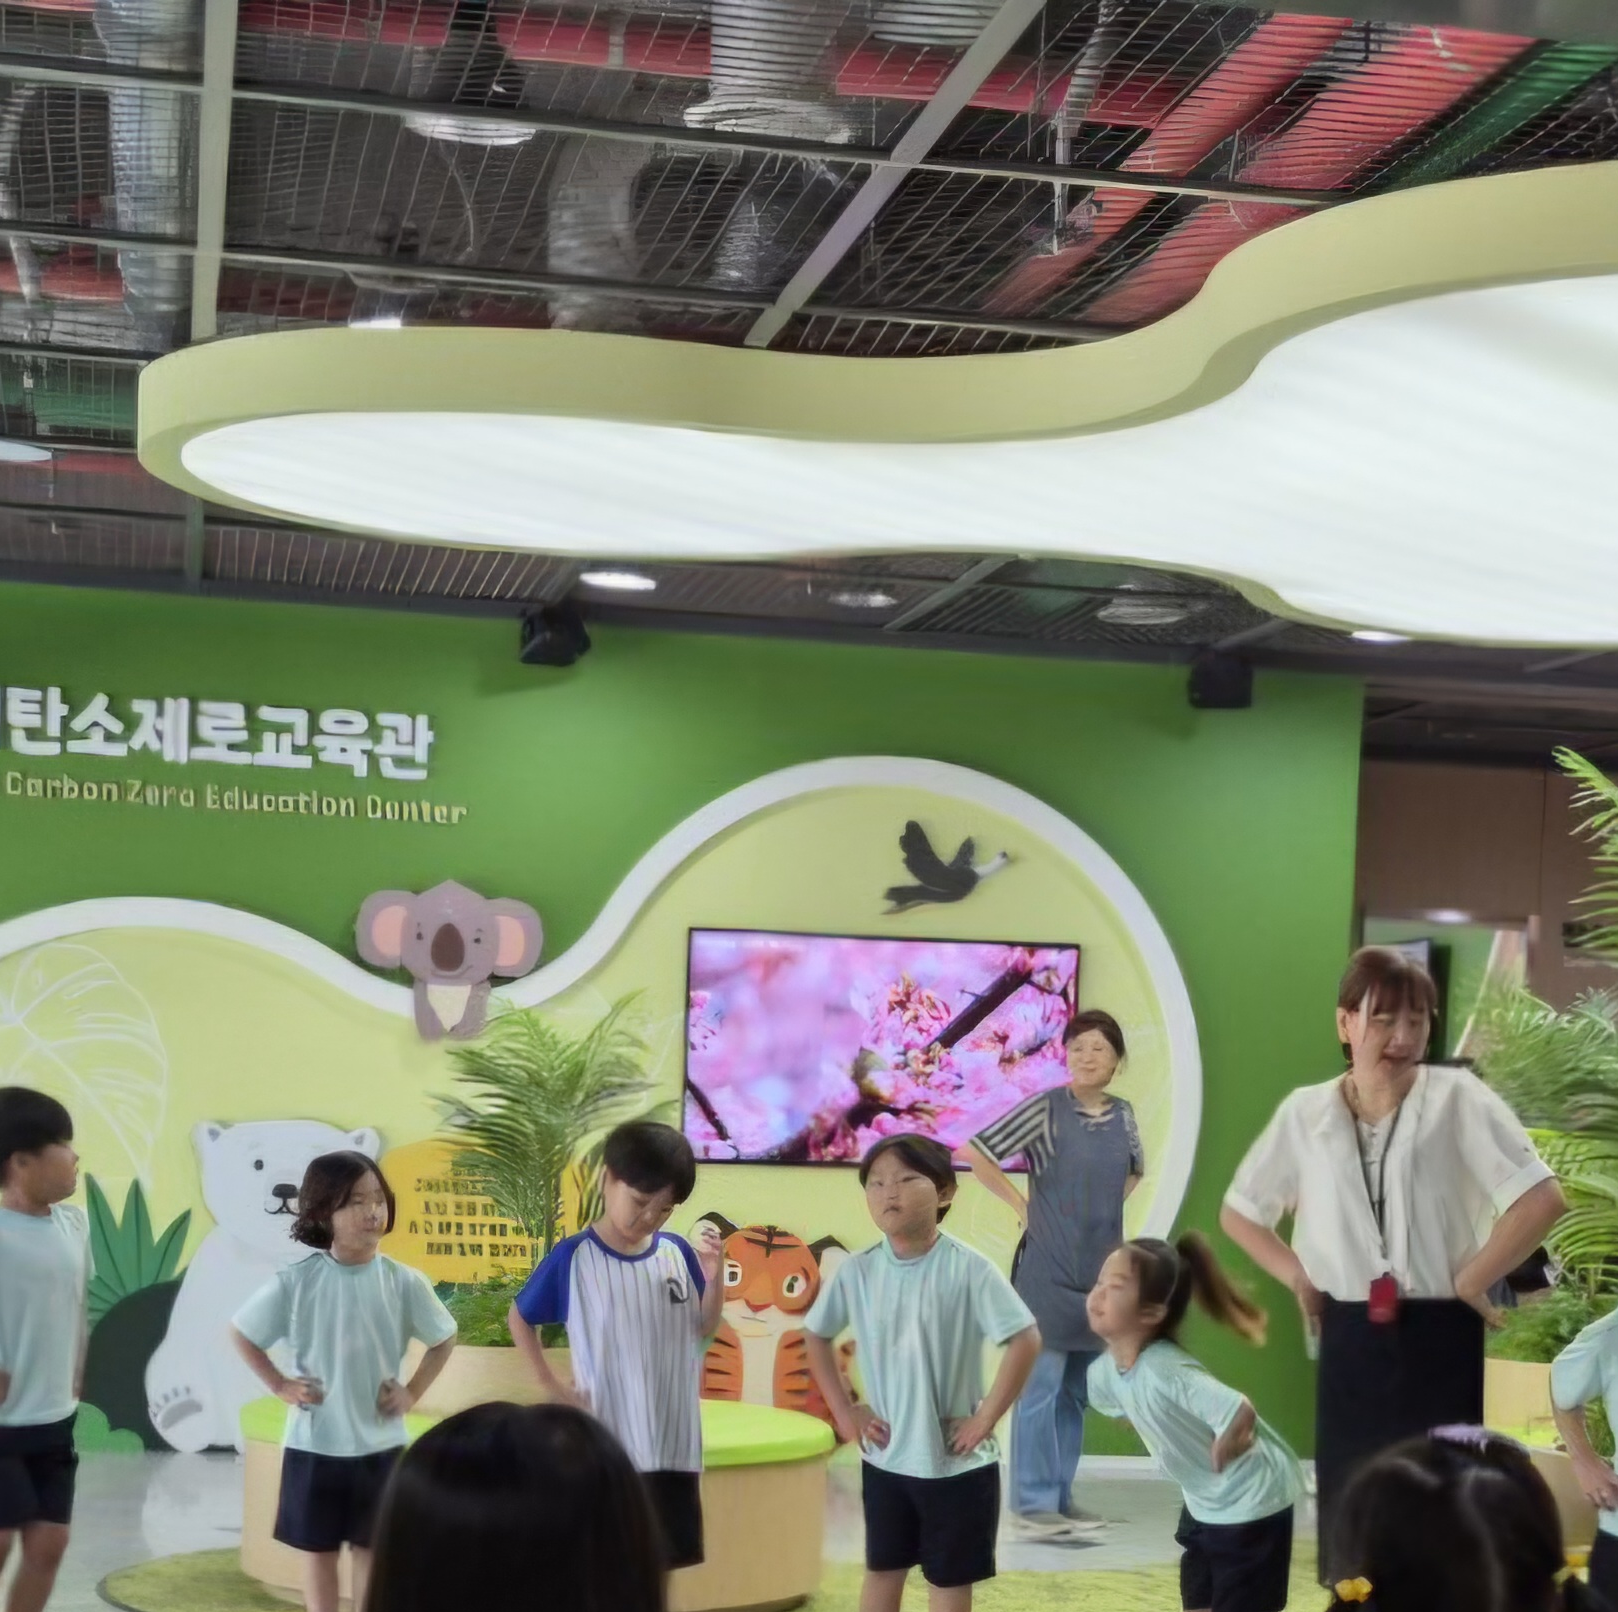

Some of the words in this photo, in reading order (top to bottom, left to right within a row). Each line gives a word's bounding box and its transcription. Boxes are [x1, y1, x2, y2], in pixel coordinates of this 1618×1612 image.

[6, 770, 119, 802] Carbon
[125, 779, 195, 807] Zero
[205, 784, 356, 817] Education
[366, 794, 468, 824] Center
